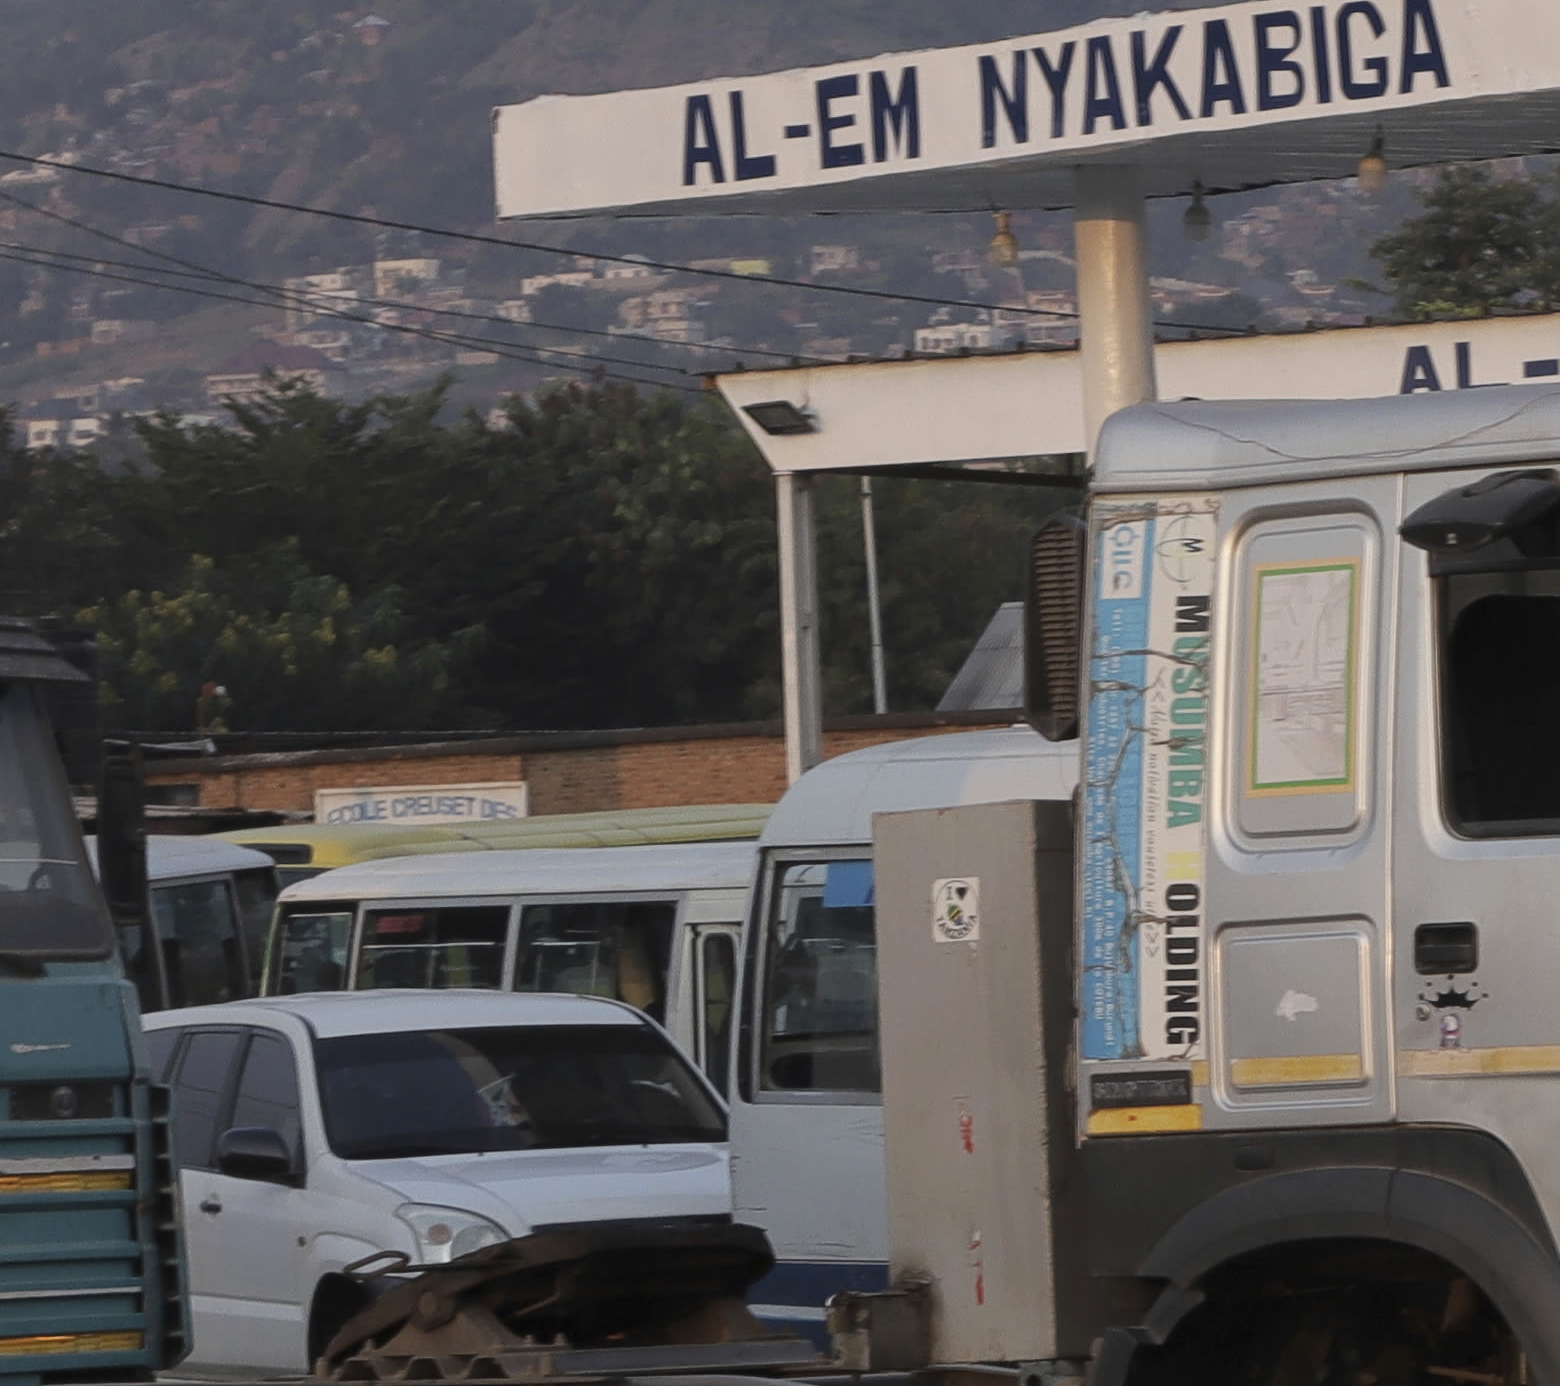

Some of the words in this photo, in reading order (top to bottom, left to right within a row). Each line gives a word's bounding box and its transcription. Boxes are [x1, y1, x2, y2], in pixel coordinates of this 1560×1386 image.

[683, 65, 919, 187] AL-EM
[1168, 596, 1210, 828] MUSUMBA
[390, 796, 476, 819] CREUSET
[481, 798, 519, 820] DES
[1165, 852, 1202, 1045] HOLDING
